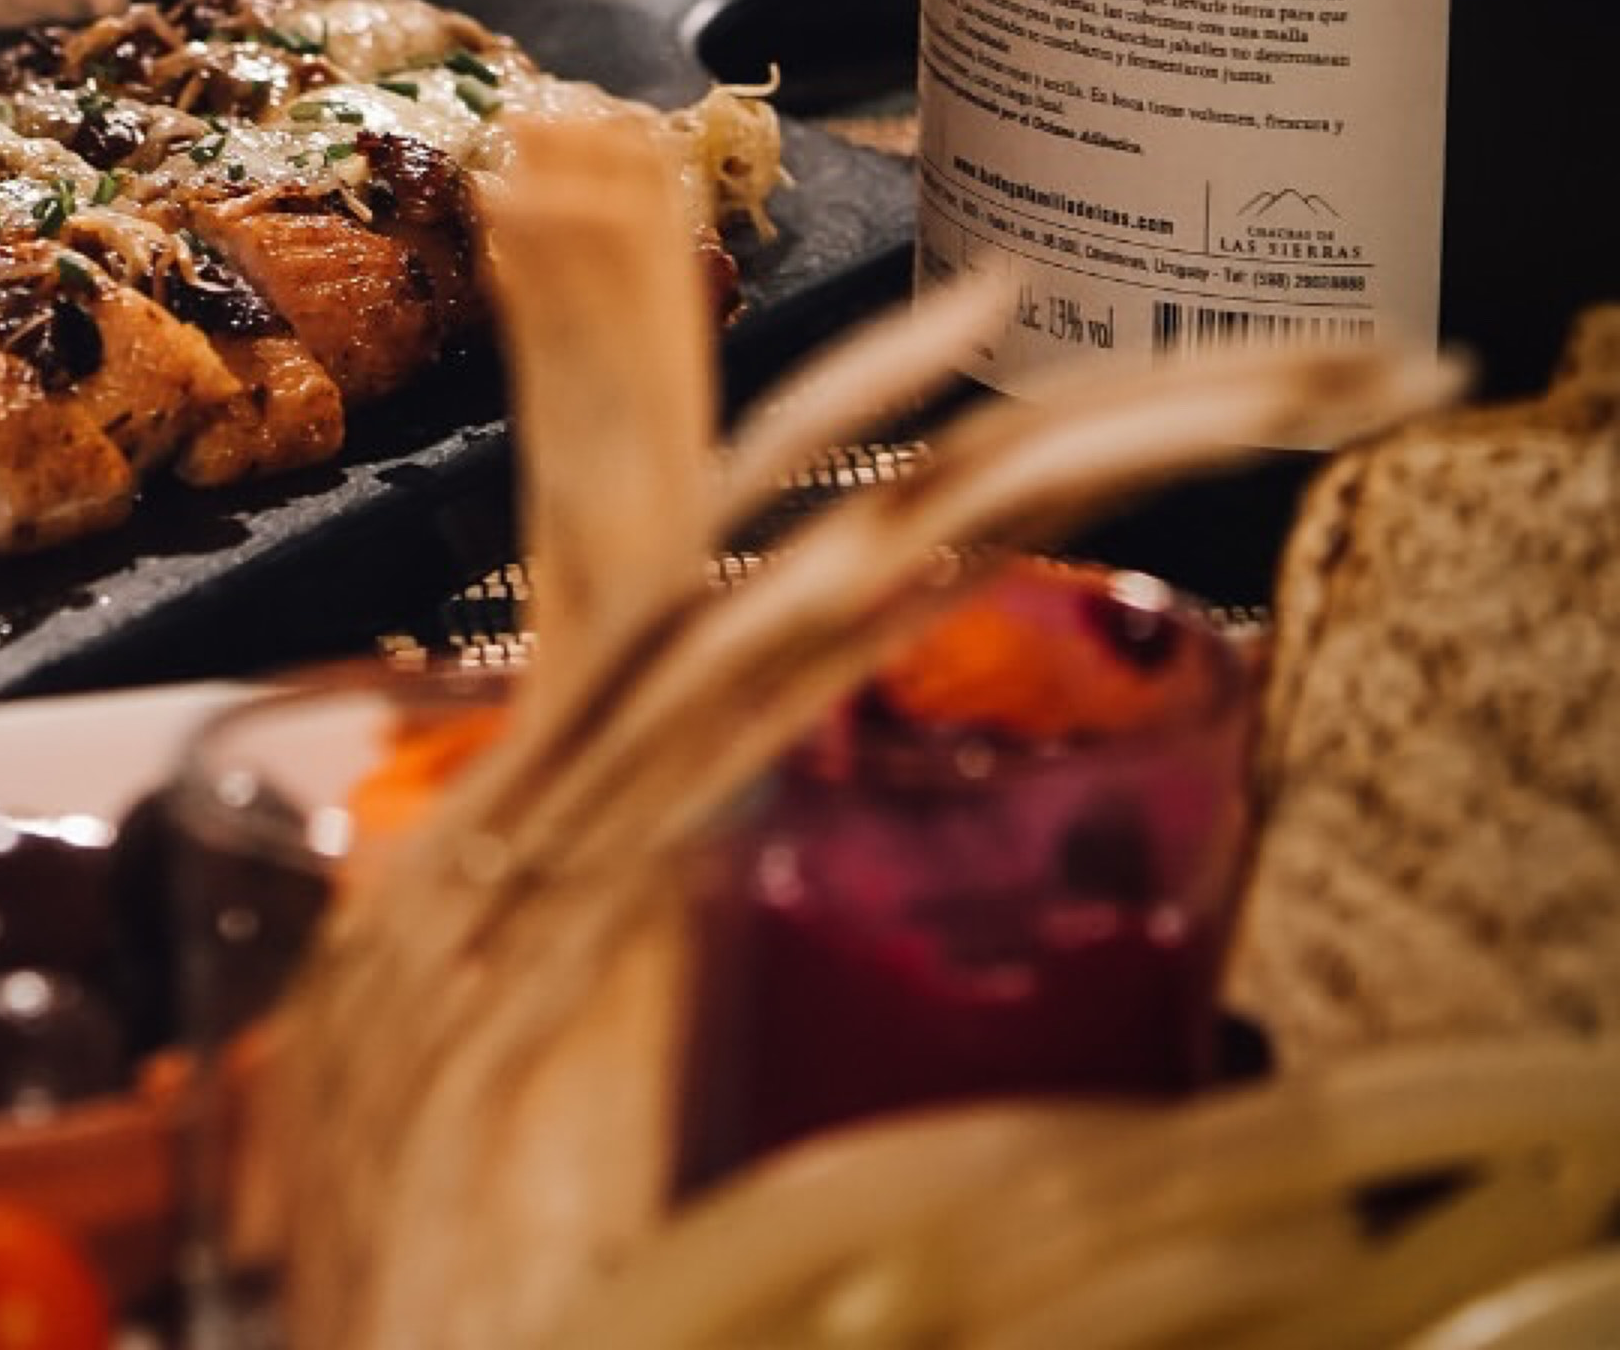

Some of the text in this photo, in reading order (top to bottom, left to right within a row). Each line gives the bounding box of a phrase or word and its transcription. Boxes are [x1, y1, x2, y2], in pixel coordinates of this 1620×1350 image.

[1219, 236, 1363, 259] LAS SIERRAS
[1087, 304, 1114, 350] vol
